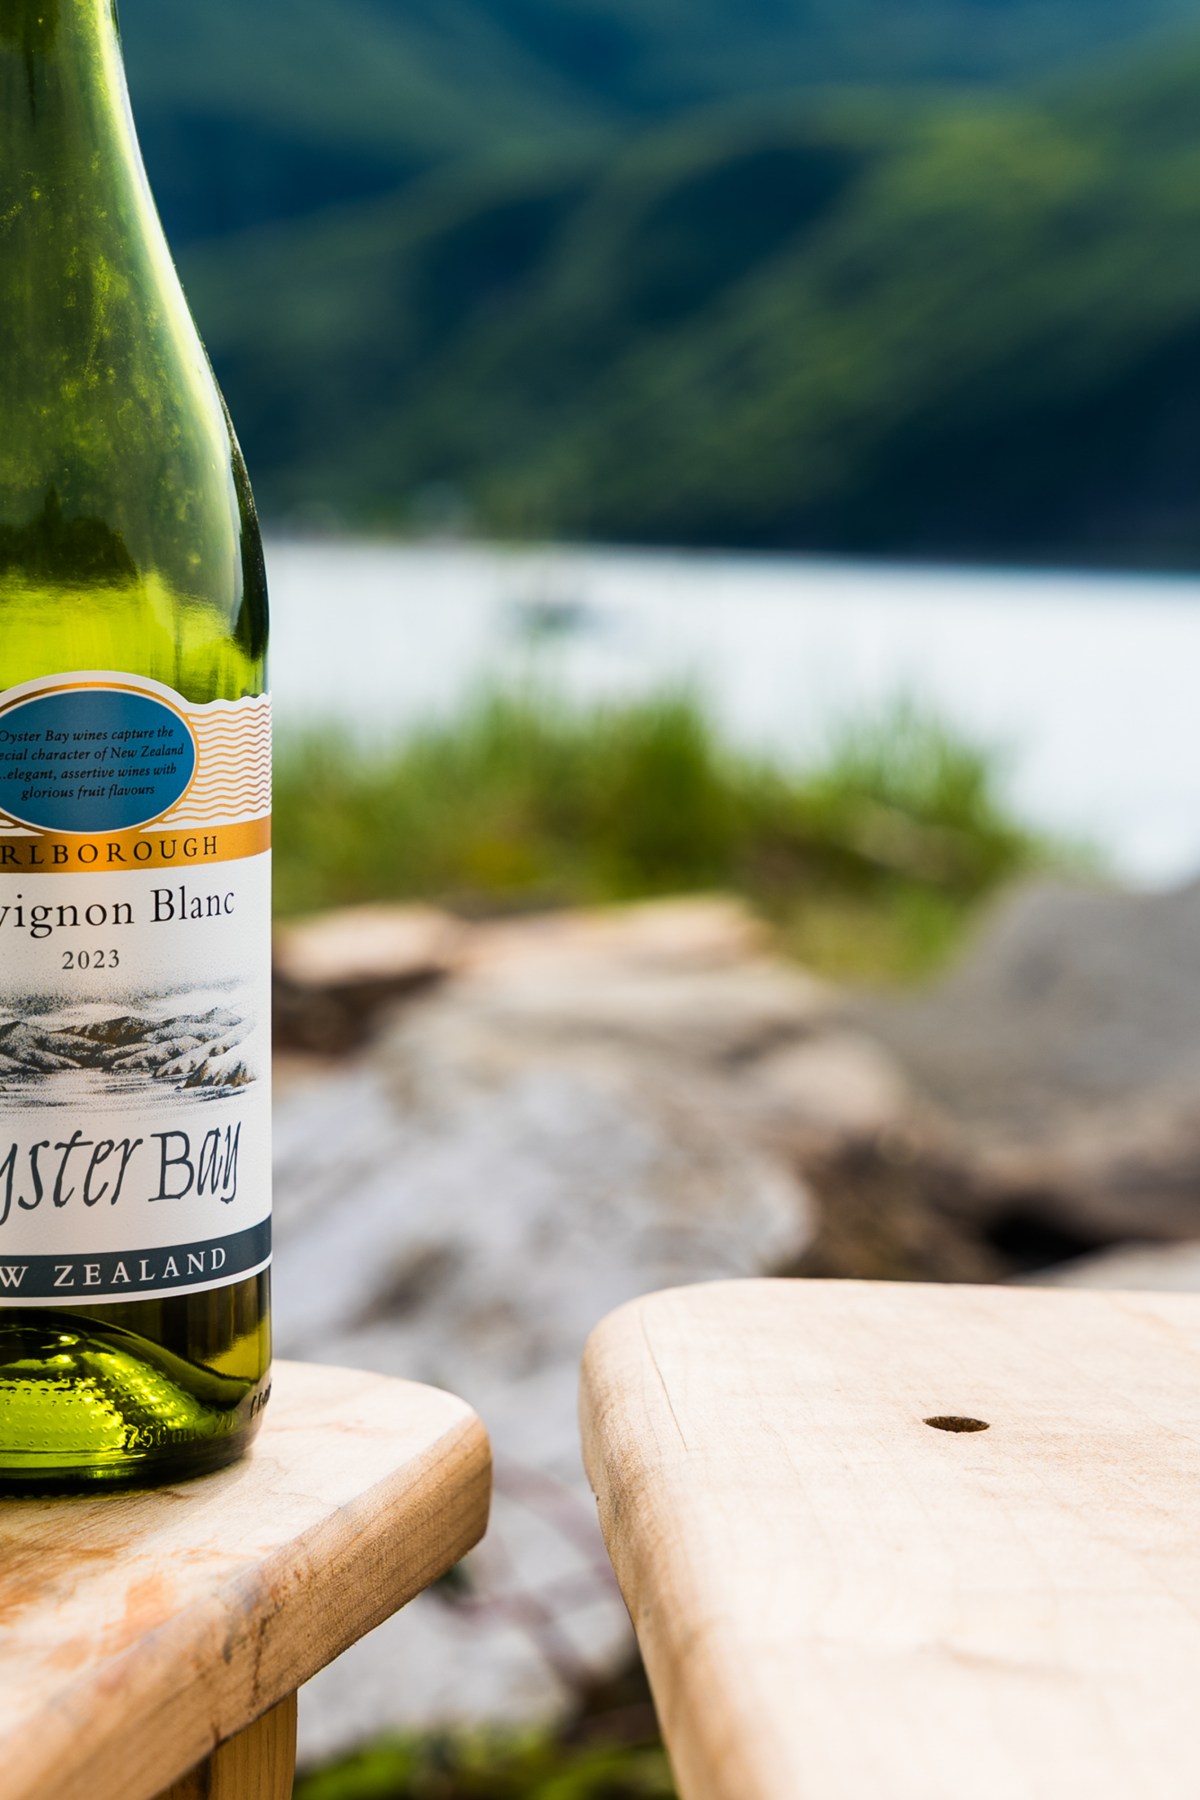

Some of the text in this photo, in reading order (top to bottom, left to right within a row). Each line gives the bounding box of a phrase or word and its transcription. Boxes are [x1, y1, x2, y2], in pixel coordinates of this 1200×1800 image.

[45, 729, 69, 744] Bay
[73, 729, 108, 741] wines
[111, 728, 154, 743] capture
[157, 725, 174, 738] the
[31, 748, 90, 760] character
[94, 746, 109, 762] of
[110, 746, 137, 759] New
[140, 743, 184, 757] Zealand
[61, 766, 114, 779] assertive
[118, 765, 150, 777] wines
[153, 762, 177, 775] with
[21, 783, 155, 801] glorious fruit flavours
[149, 886, 236, 923] Blanc
[61, 949, 121, 970] 2023
[148, 1120, 243, 1205] Bay
[53, 1246, 228, 1288] ZEALAND
